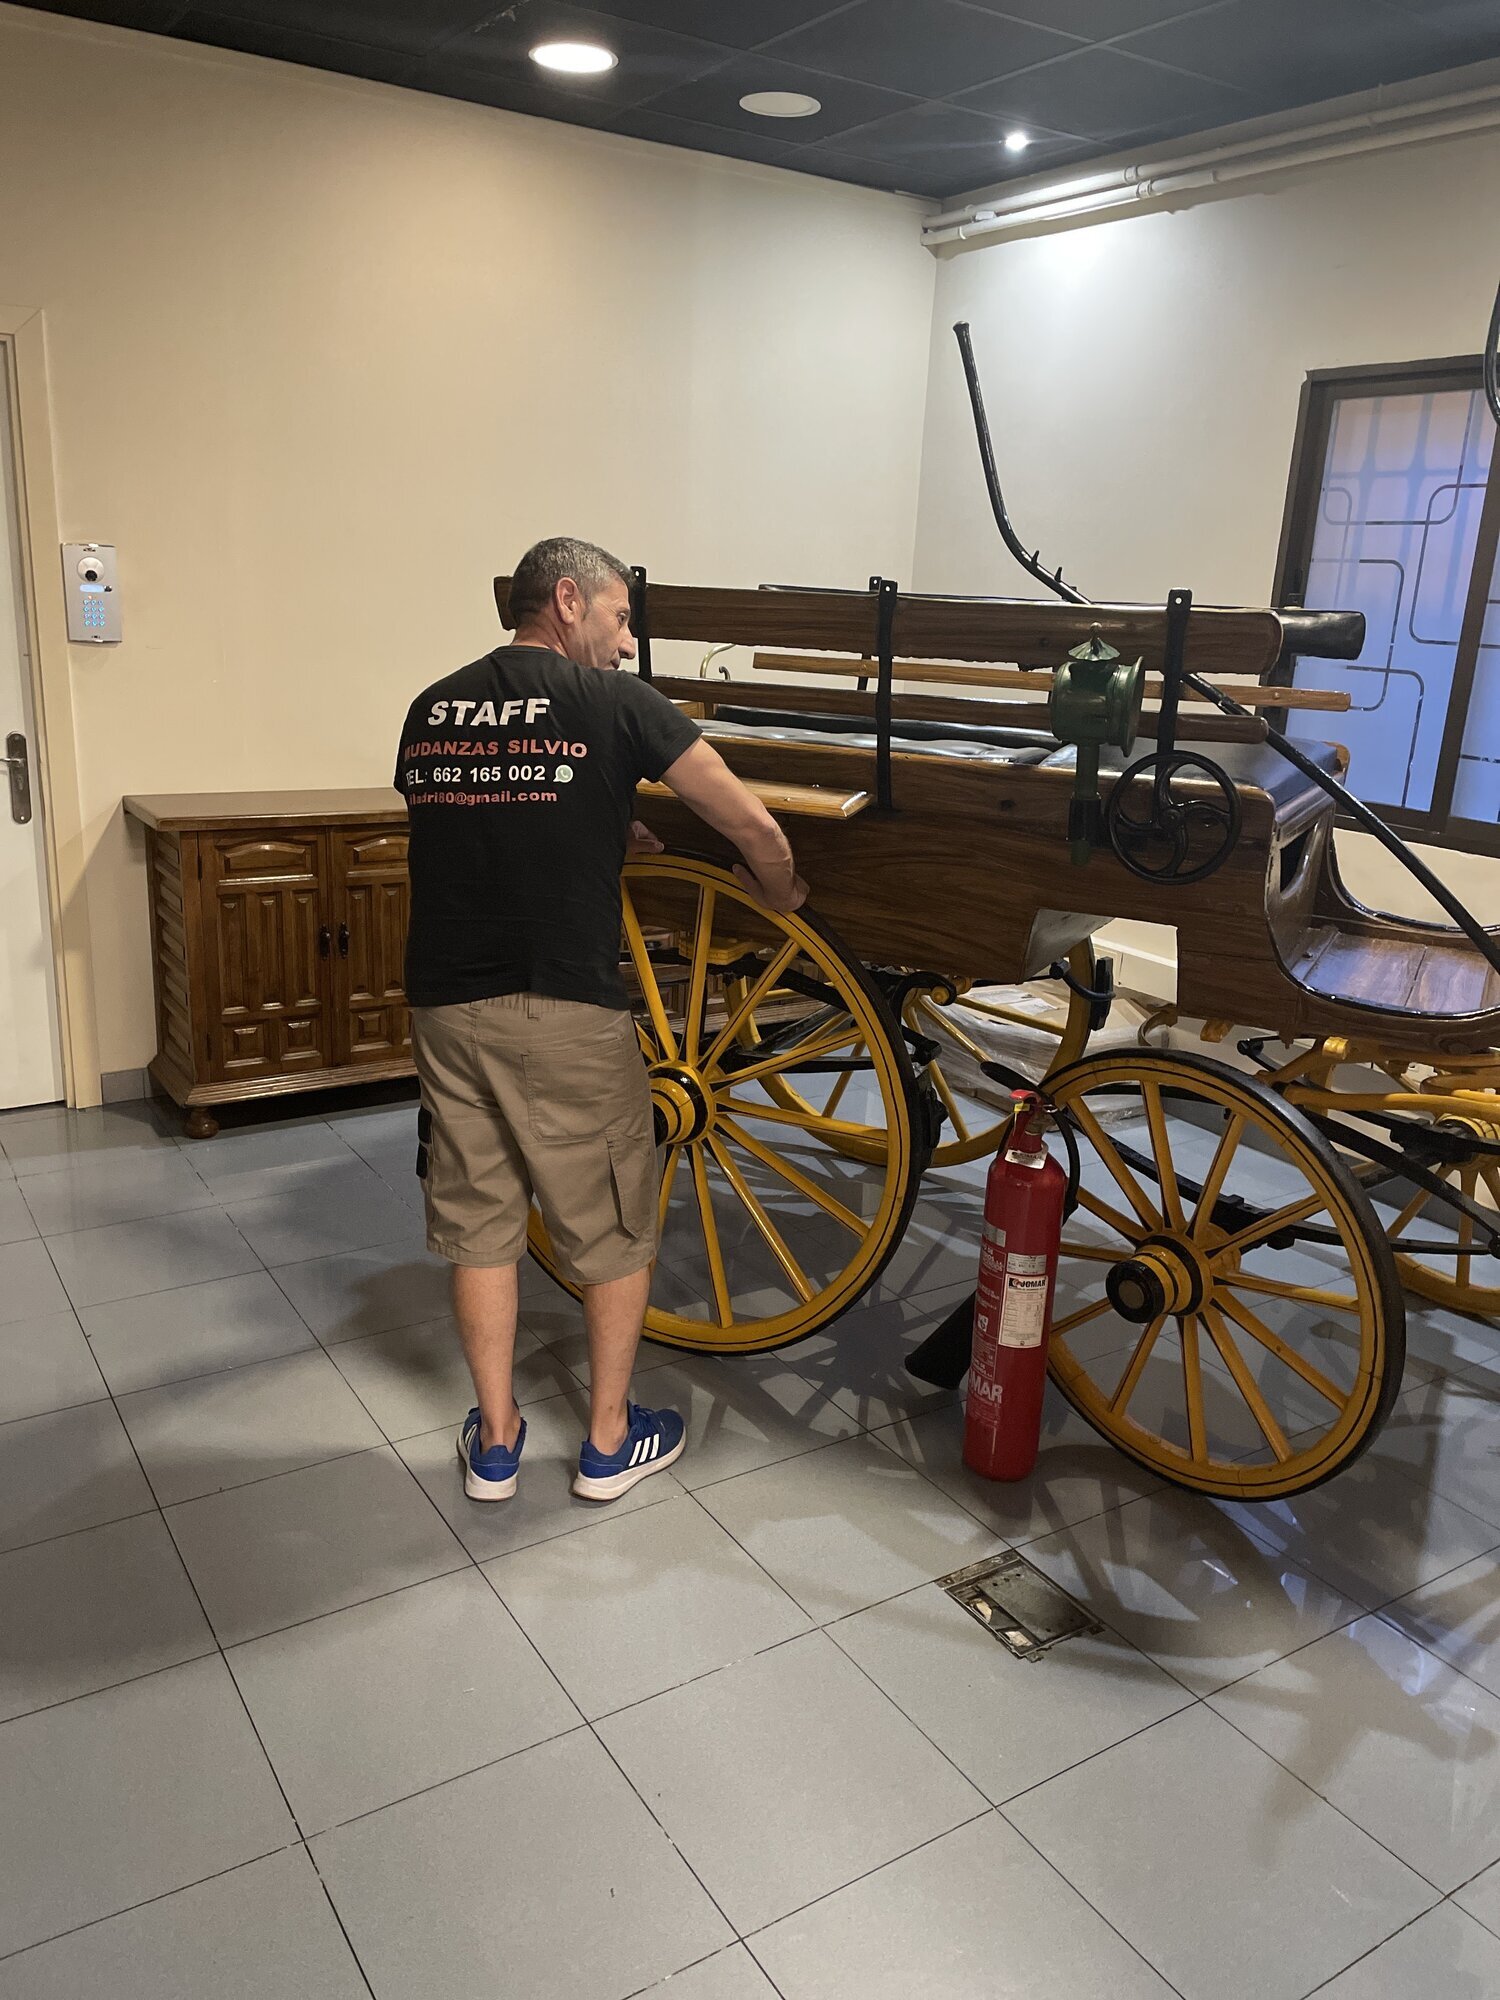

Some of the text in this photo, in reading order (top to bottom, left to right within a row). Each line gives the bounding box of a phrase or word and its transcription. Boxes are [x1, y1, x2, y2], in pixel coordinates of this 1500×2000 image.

[427, 698, 550, 726] STAFF
[507, 739, 588, 758] SILVIO
[433, 767, 462, 783] 662
[470, 767, 501, 783] 165
[508, 765, 546, 781] 002
